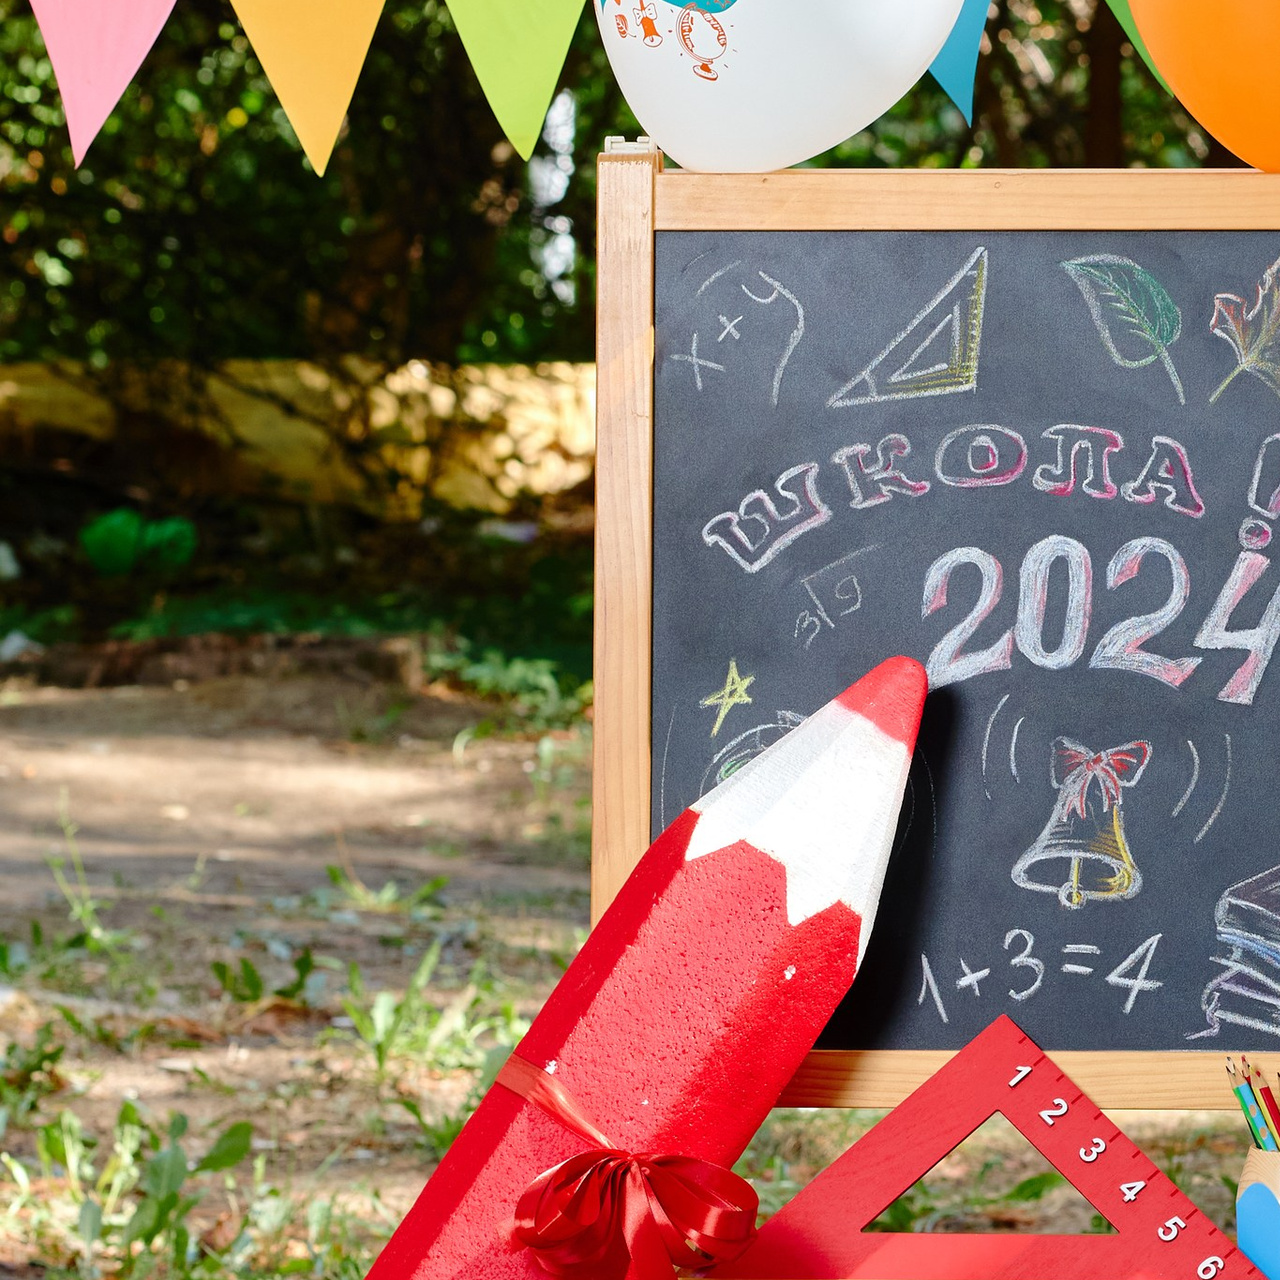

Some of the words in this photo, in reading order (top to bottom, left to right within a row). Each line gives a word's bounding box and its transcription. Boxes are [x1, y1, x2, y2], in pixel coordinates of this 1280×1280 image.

[1008, 1065, 1033, 1088] 1
[1038, 1098, 1069, 1126] 2
[1079, 1137, 1107, 1163] 3
[1119, 1180, 1147, 1204] 4
[1157, 1216, 1187, 1242] 5
[1197, 1255, 1224, 1280] 6
